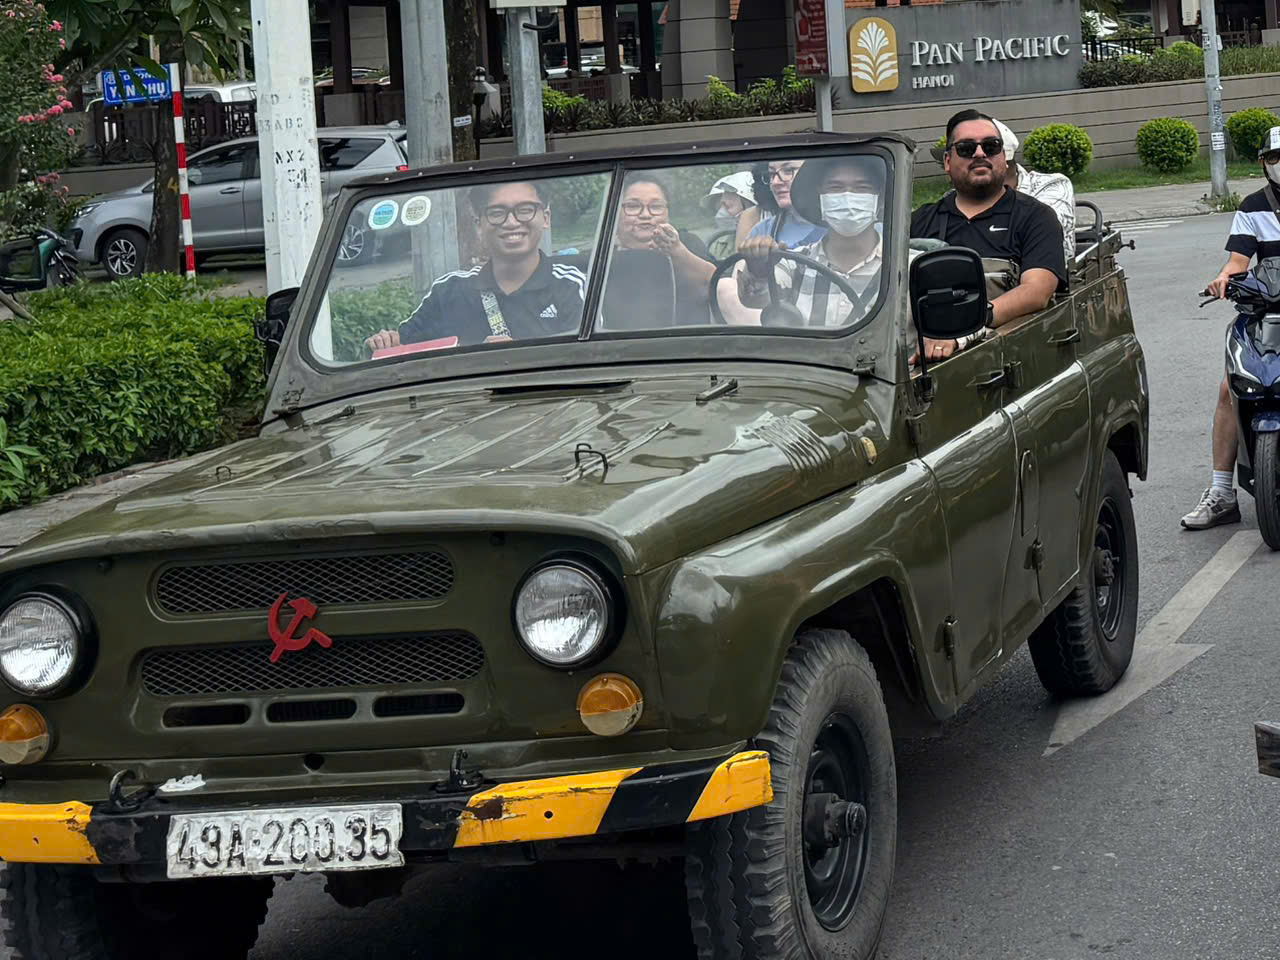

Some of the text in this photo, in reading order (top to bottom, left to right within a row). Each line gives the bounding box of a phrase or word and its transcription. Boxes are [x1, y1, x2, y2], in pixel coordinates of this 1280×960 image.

[911, 34, 1070, 66] PAN PACIFIC
[912, 74, 955, 89] HANOI
[109, 84, 136, 98] YN
